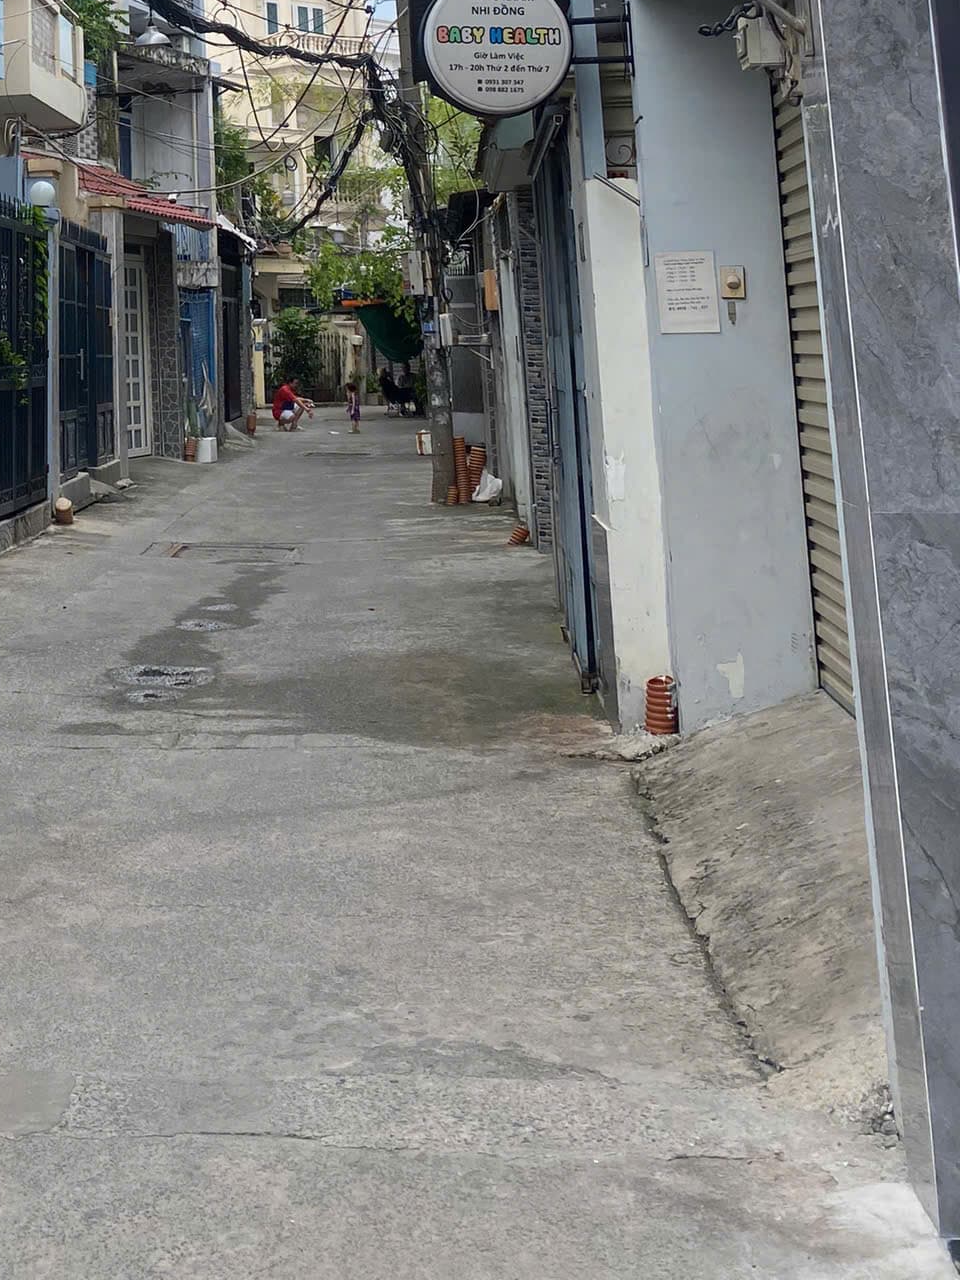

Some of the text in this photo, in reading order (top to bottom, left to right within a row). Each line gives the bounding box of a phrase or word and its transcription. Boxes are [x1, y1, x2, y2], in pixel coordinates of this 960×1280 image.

[471, 3, 525, 16] NHI ĐỒNG
[436, 25, 561, 45] BABY HEALTH
[473, 51, 524, 61] Giờ Làm Việc
[470, 64, 484, 72] 20h
[486, 64, 502, 72] Thứ
[510, 64, 525, 72] đến
[527, 65, 543, 73] Thứ
